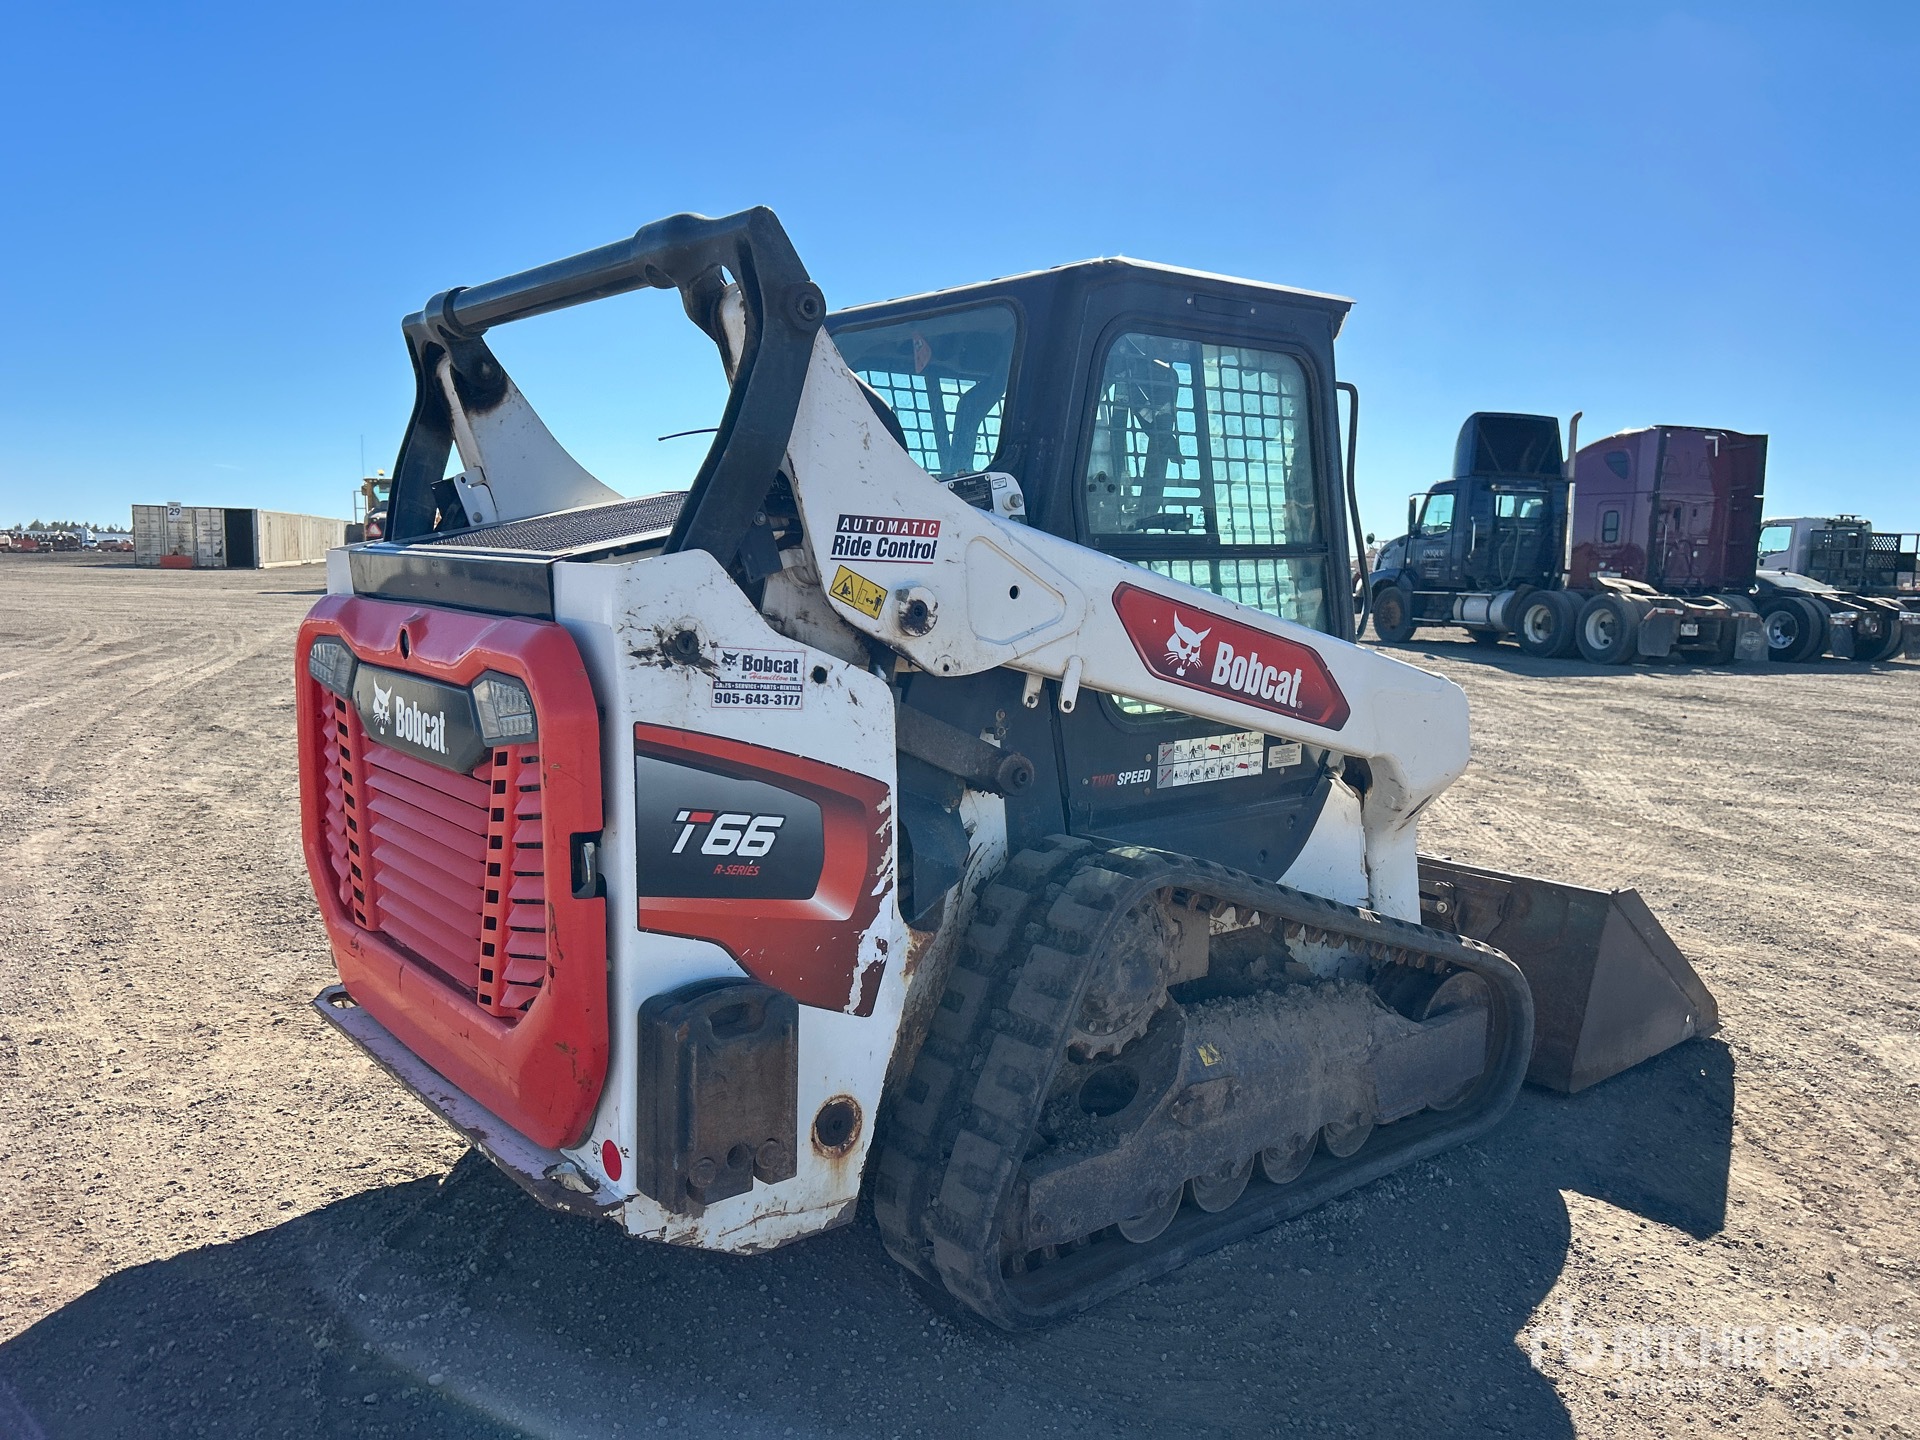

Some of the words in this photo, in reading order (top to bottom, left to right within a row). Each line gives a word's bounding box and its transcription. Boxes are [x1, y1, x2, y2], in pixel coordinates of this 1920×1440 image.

[168, 507, 181, 516] 29
[840, 517, 937, 536] AUTOMATIC
[831, 534, 872, 556] Ride
[876, 537, 938, 560] Control
[742, 654, 798, 673] Bobcat
[1211, 641, 1302, 709] Bobcat
[714, 692, 801, 705] 905-643-3177
[395, 695, 446, 754] Bobcat
[1092, 774, 1116, 787] TWO
[1116, 769, 1151, 786] SPEED
[672, 810, 785, 857] T66
[713, 864, 761, 876] R-SERIES
